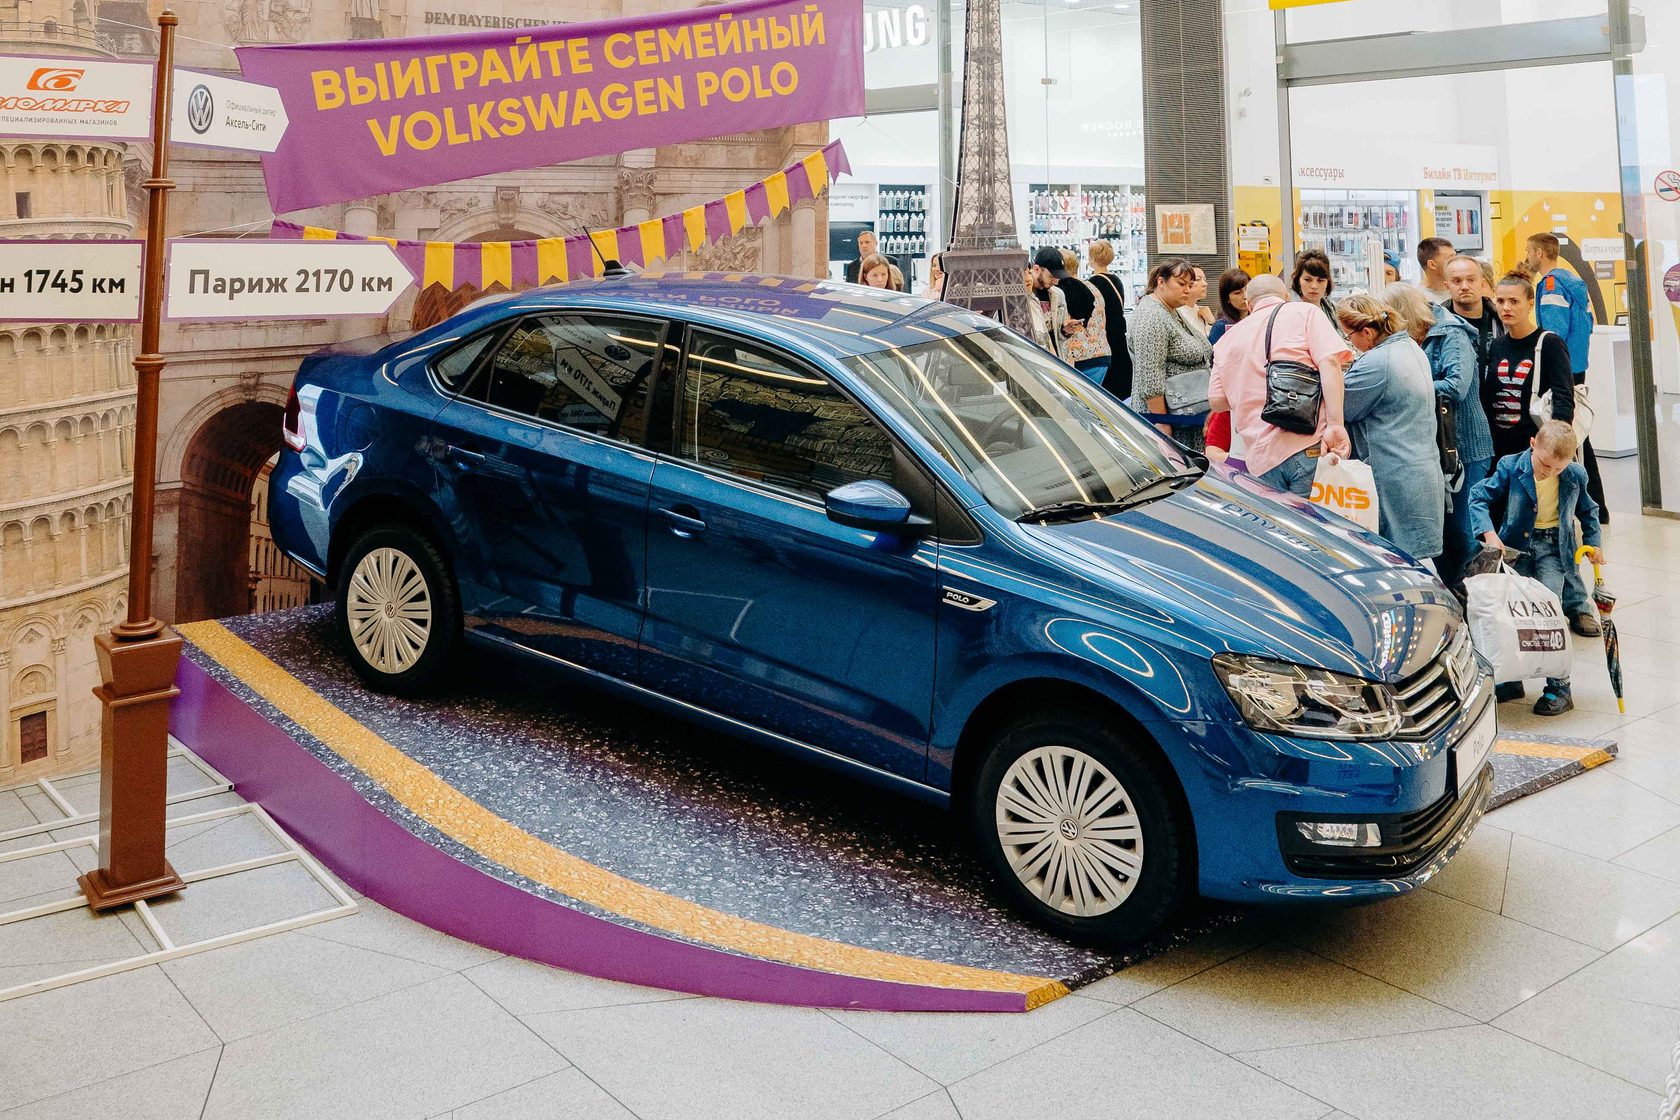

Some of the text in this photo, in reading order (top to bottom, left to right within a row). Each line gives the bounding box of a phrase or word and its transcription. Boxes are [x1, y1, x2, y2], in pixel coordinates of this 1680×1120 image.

[424, 11, 456, 26] DEM
[311, 4, 826, 111] ВЫИГРАЙТЕ СЕМЕЙНЫЙ
[0, 96, 130, 114] ЛОМАРКА
[366, 61, 799, 157] VOLKSWAGEN POLO
[225, 115, 267, 132] Аксель-Сити
[1423, 166, 1450, 179] Билайн
[24, 269, 84, 294] 1745
[91, 277, 125, 293] км
[188, 268, 393, 301] Париж 2170 км
[946, 591, 970, 604] POLO
[1508, 600, 1558, 617] KIABI
